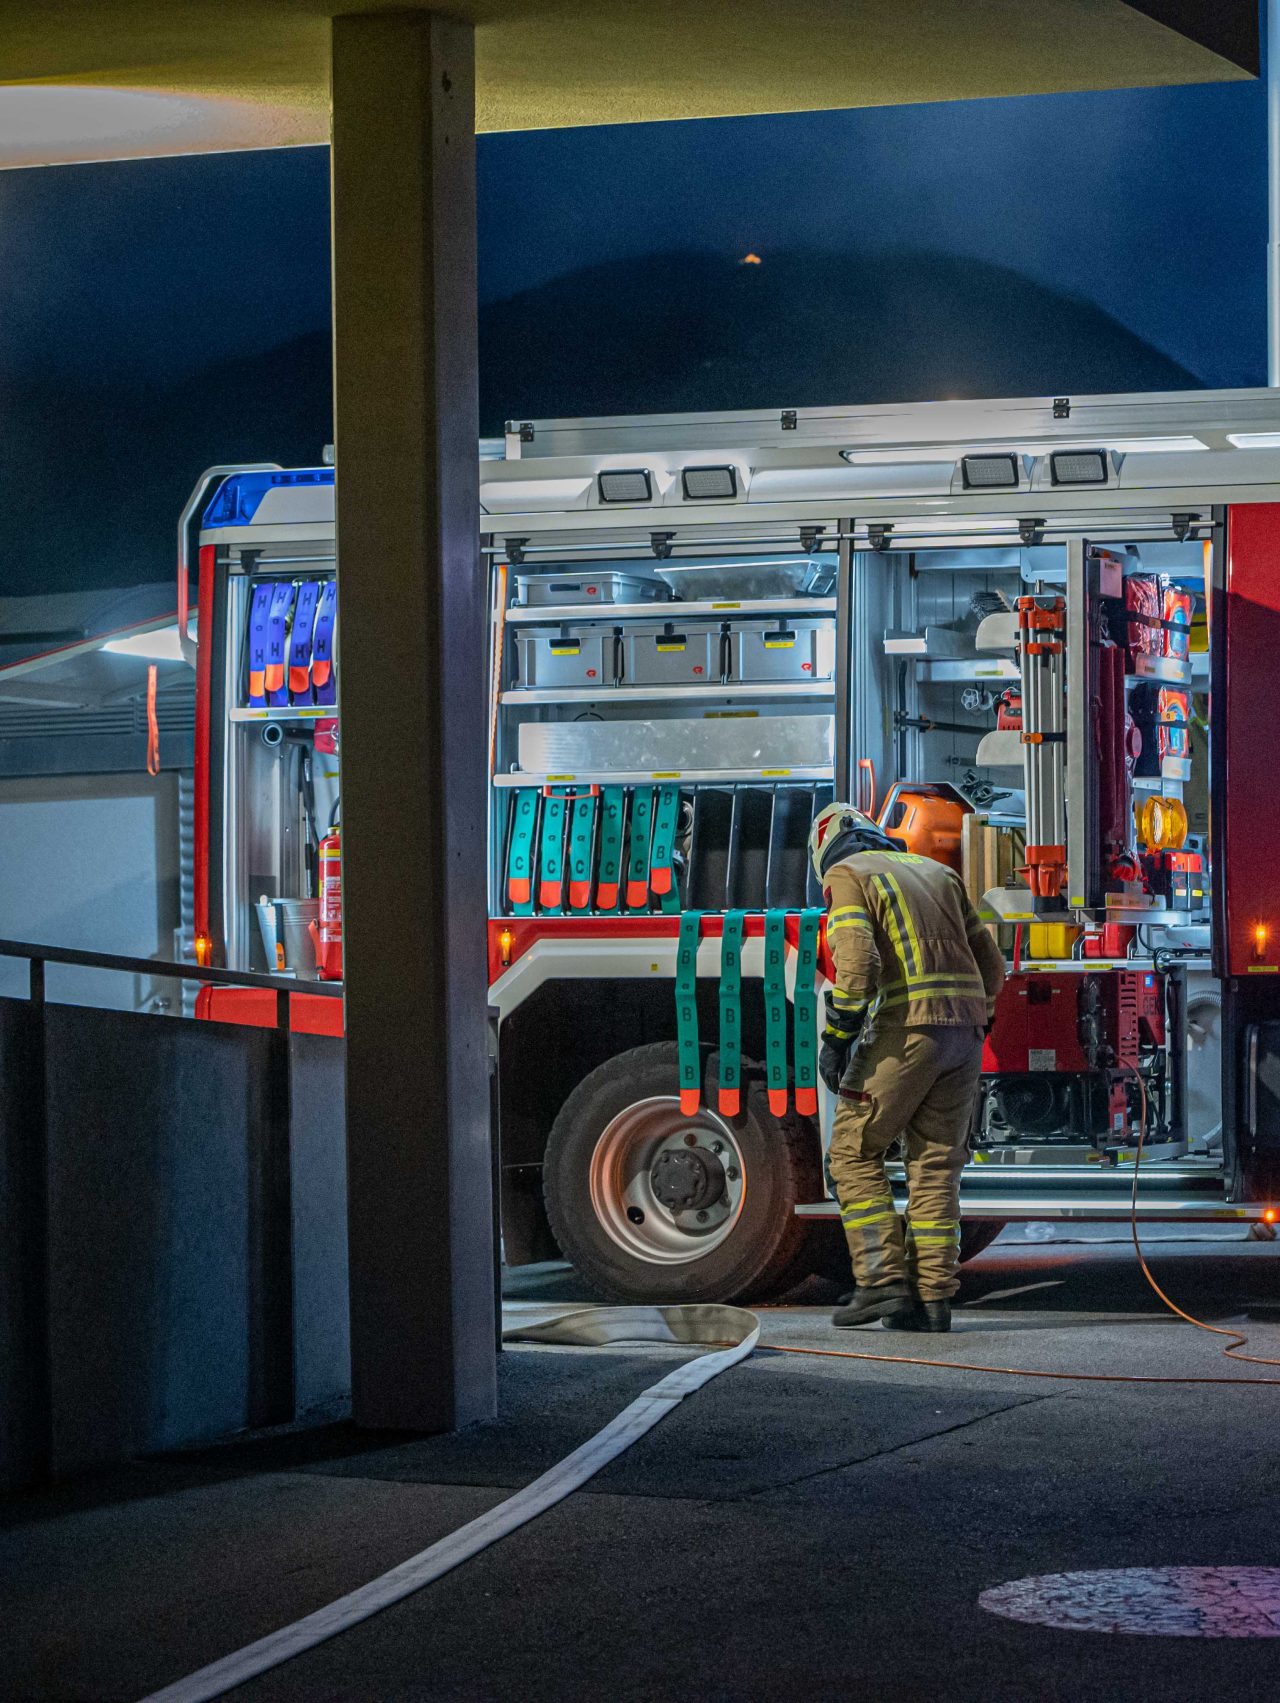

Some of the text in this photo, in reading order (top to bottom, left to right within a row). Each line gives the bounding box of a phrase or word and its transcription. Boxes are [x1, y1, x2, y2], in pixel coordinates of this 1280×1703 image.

[258, 595, 266, 608] H
[277, 592, 286, 603] H
[303, 592, 312, 605] H
[326, 589, 336, 600] H
[272, 642, 279, 656] H
[296, 644, 305, 658] H
[318, 641, 325, 653] H
[256, 649, 263, 662] H
[664, 792, 672, 806] B
[522, 802, 530, 815] C
[551, 804, 559, 817] C
[579, 803, 588, 817] C
[608, 804, 617, 818] C
[637, 802, 646, 816] C
[657, 846, 664, 859] B
[515, 856, 524, 870] C
[547, 860, 556, 874] C
[576, 859, 584, 874] C
[605, 862, 614, 875] C
[635, 860, 643, 874] C
[682, 951, 690, 964] B
[726, 952, 734, 966] B
[770, 950, 779, 964] B
[803, 950, 811, 964] B
[683, 1007, 691, 1022] B
[726, 1008, 735, 1023] B
[772, 1007, 780, 1022] B
[800, 1007, 810, 1022] B
[685, 1066, 694, 1080] B
[725, 1067, 734, 1081] B
[773, 1066, 782, 1081] B
[801, 1066, 810, 1080] B
